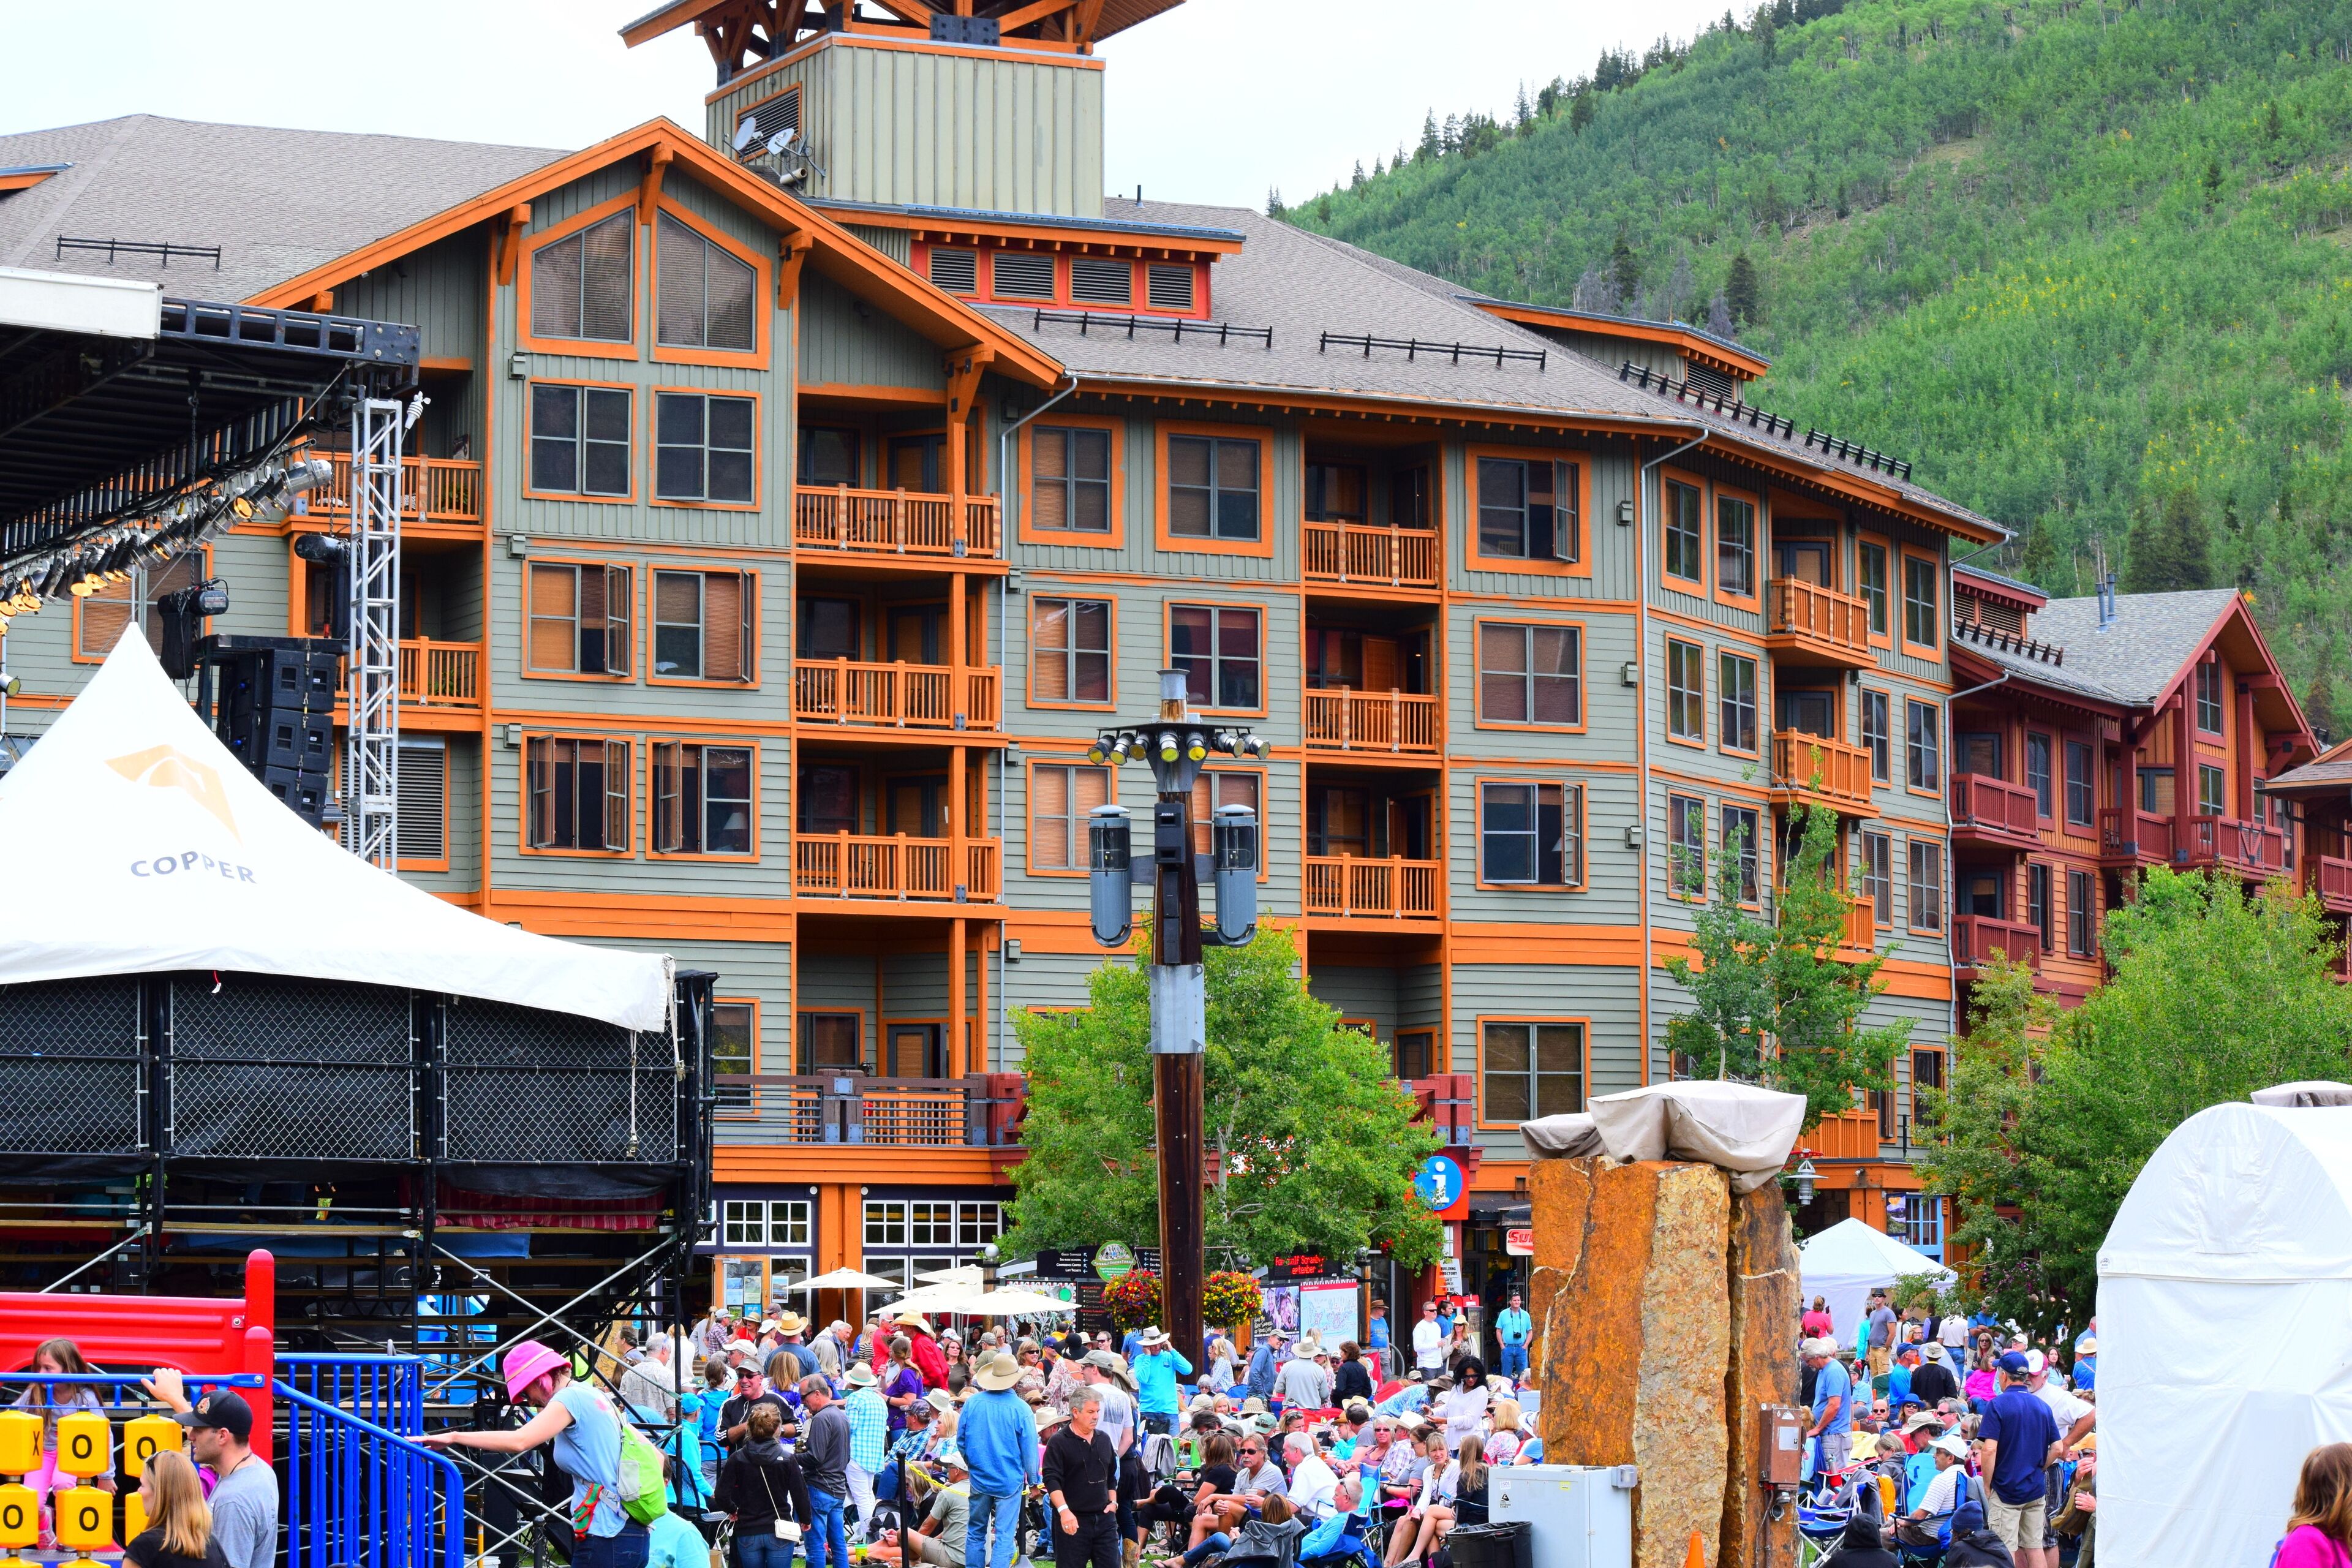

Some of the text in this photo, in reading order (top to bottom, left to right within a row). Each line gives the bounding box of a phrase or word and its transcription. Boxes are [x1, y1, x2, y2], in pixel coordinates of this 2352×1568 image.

[131, 851, 257, 884] COPPER
[32, 1430, 40, 1457] X
[72, 1434, 92, 1459] O
[3, 1504, 23, 1529] O
[79, 1506, 99, 1531] O
